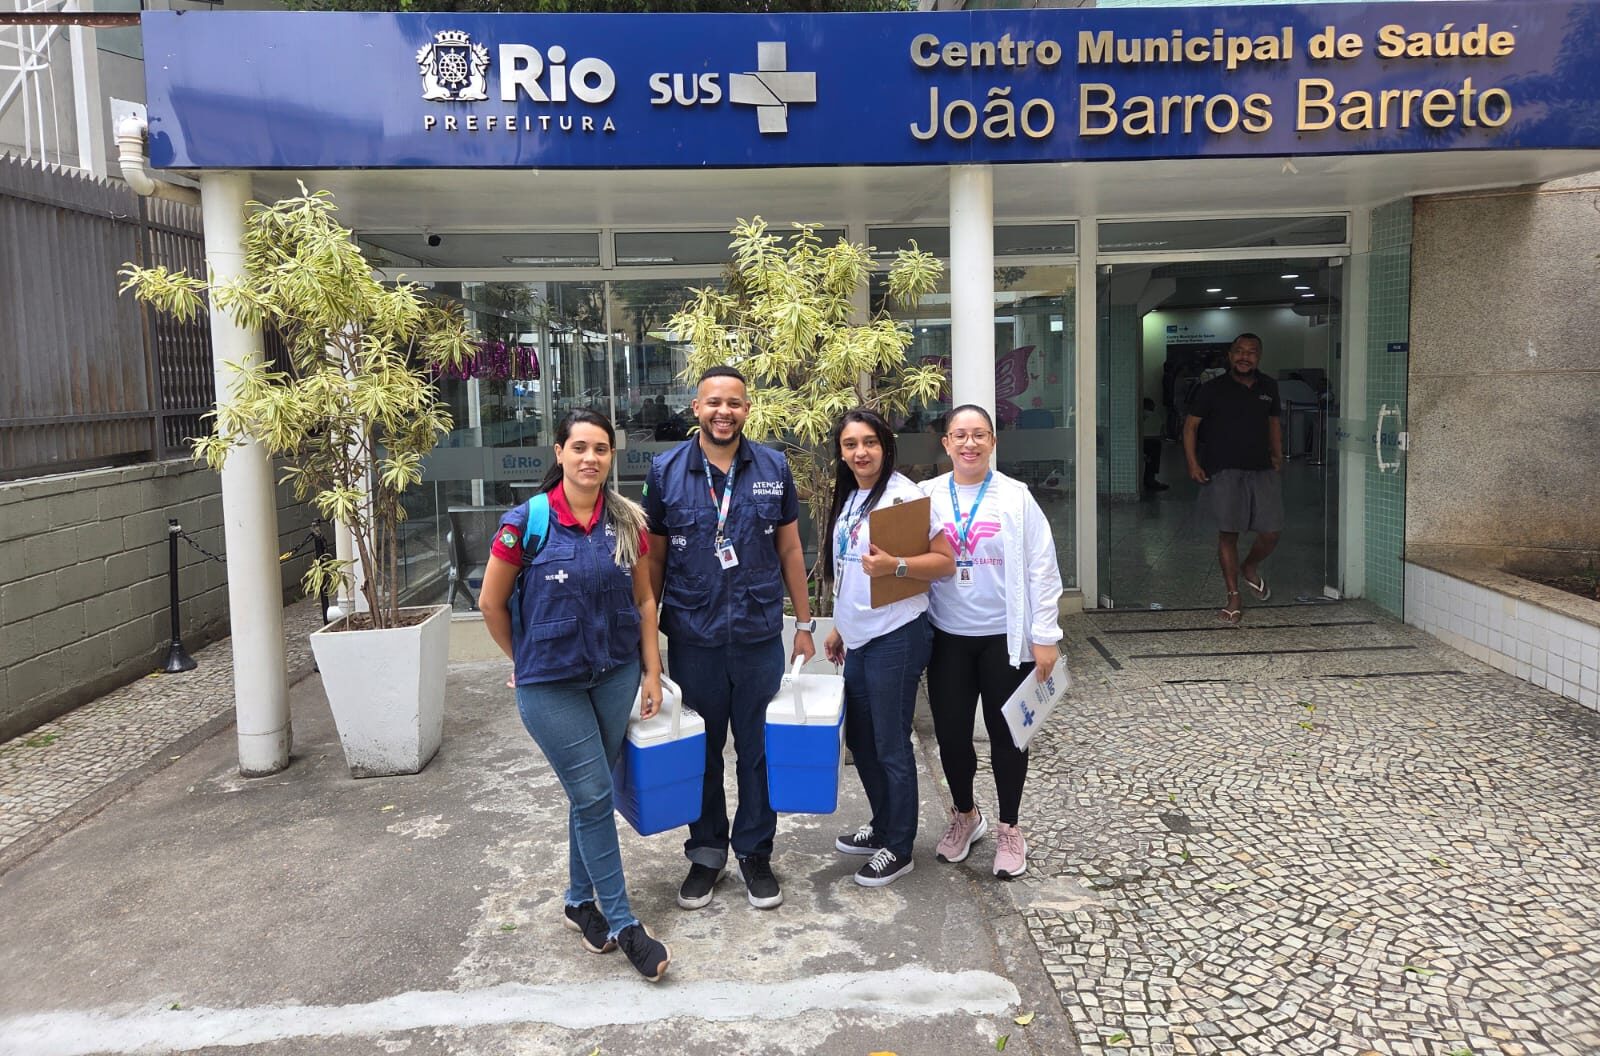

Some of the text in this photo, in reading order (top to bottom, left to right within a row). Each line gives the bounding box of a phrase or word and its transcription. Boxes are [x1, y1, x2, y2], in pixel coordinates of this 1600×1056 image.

[911, 22, 1516, 70] Centro Municipal de Saúde
[498, 42, 617, 104] Rio
[649, 72, 723, 106] SUS
[424, 115, 616, 132] PREFEITURA
[910, 76, 1513, 141] João Barros Barreto
[518, 456, 542, 468] Rio
